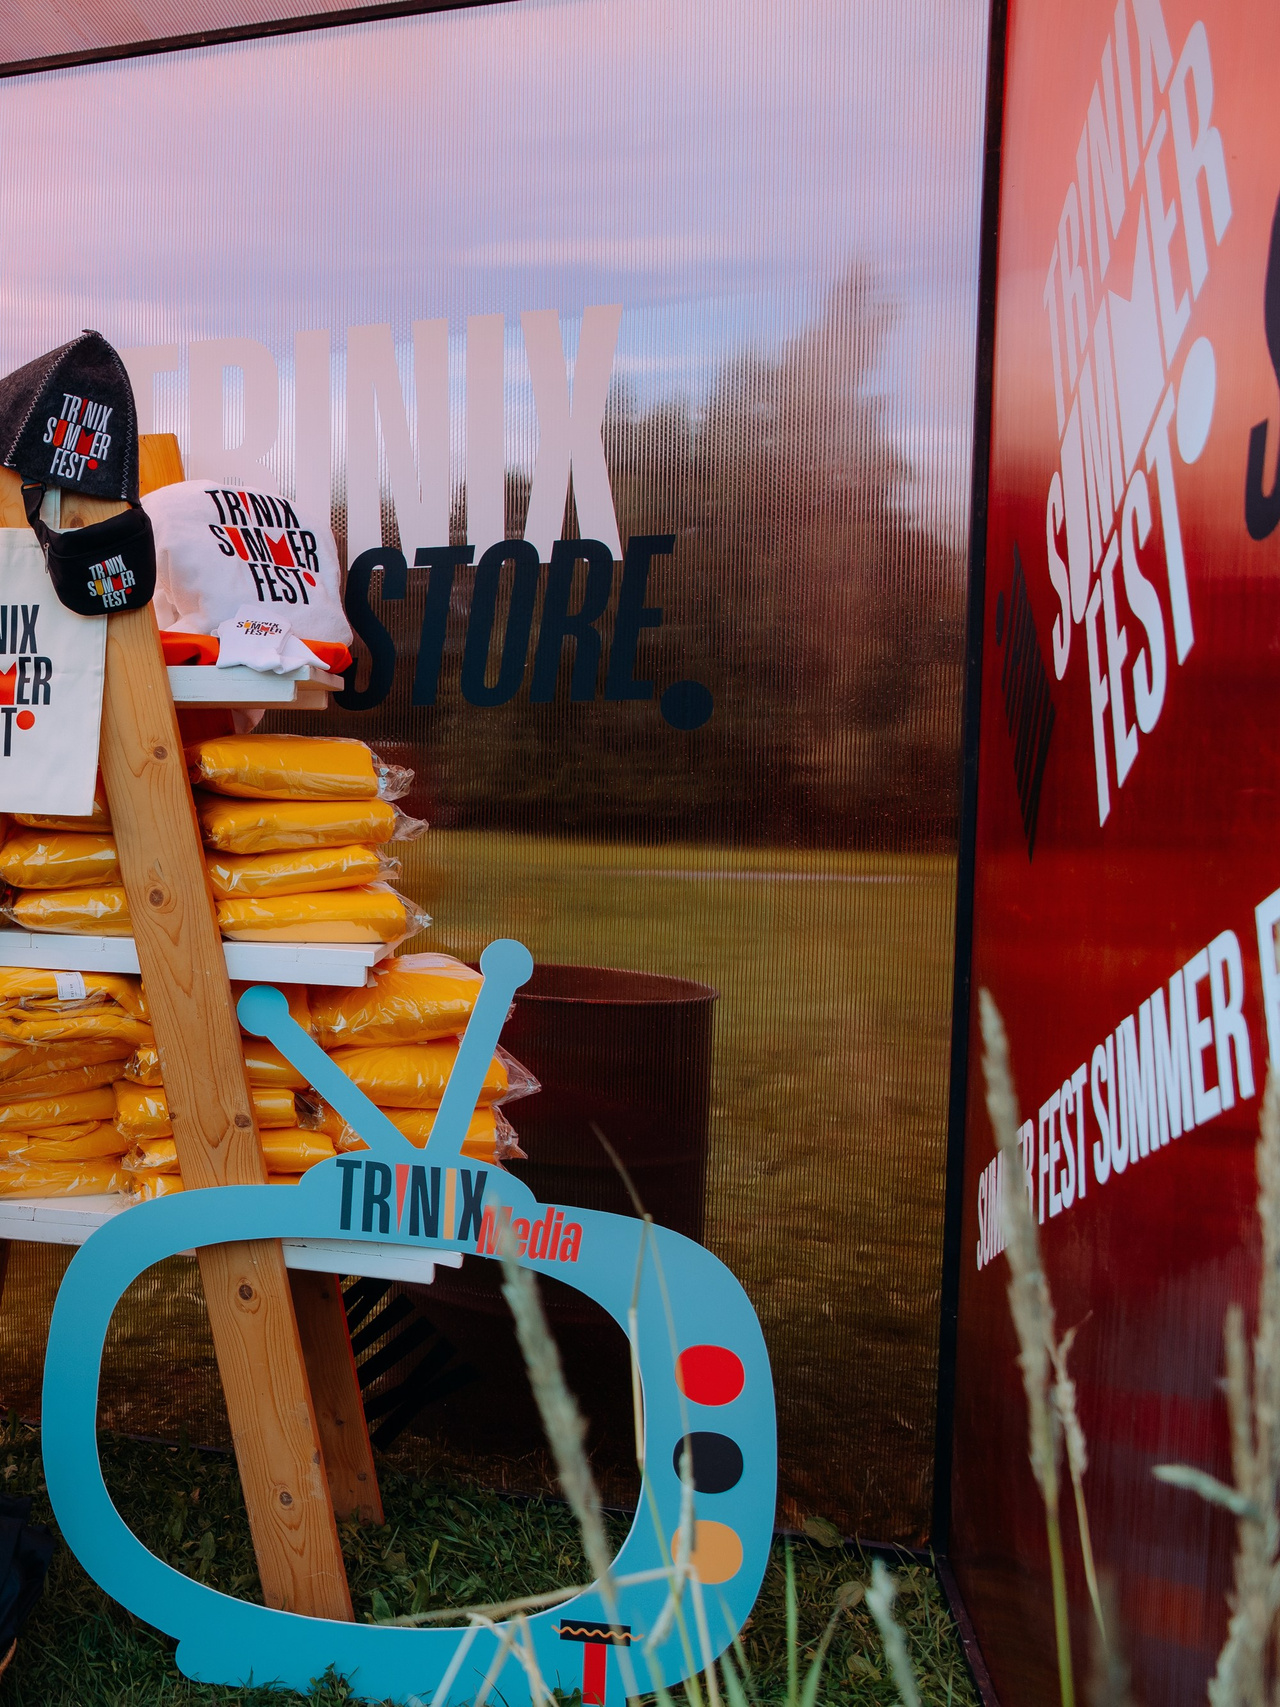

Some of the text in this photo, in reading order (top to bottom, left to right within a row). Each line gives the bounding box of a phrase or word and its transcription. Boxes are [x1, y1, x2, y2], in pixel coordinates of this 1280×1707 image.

[62, 392, 114, 433] TRINIX
[43, 416, 113, 461] SUMMER
[120, 303, 624, 571] TRINIX
[50, 448, 90, 482] FEST
[204, 489, 301, 529] TRINIX
[88, 554, 128, 581] TRINIX
[208, 524, 320, 573] SUMMER
[87, 569, 136, 597] SUMMER
[102, 588, 128, 608] FEST
[248, 563, 310, 605] FEST
[1038, 1062, 1088, 1225] FEST
[1091, 928, 1256, 1186] SUMMER
[336, 1158, 584, 1263] TRINIX Media
